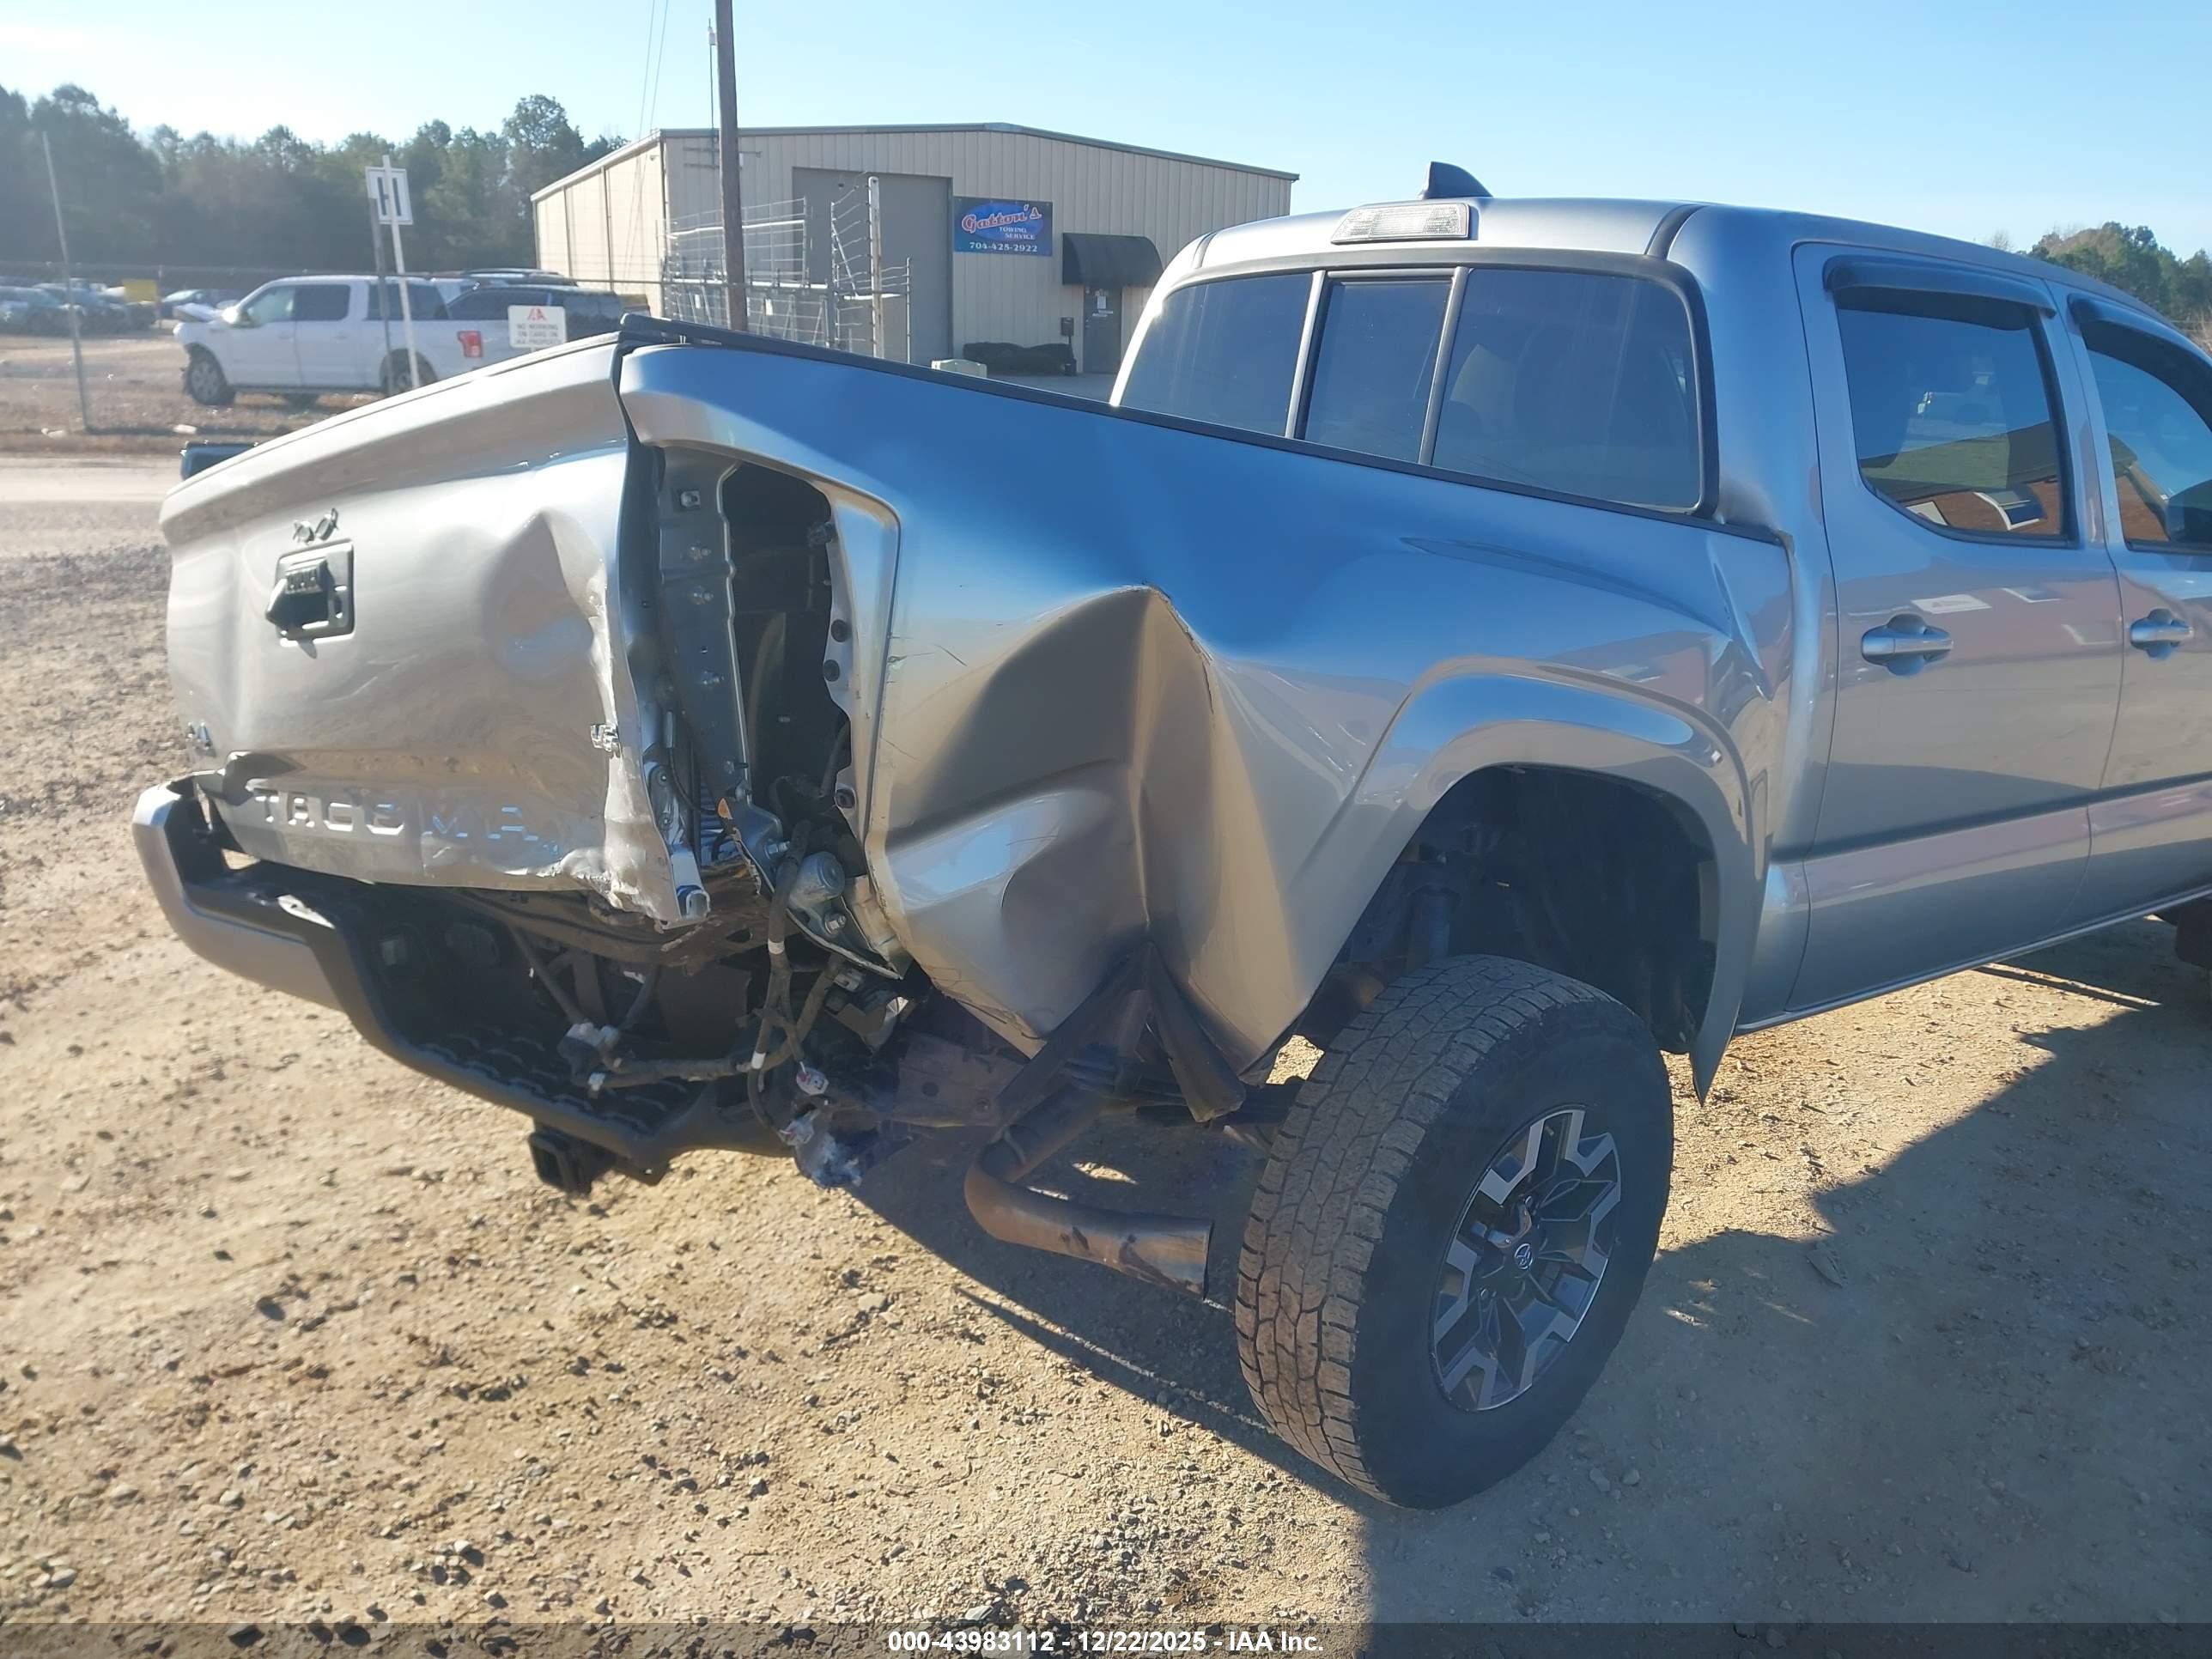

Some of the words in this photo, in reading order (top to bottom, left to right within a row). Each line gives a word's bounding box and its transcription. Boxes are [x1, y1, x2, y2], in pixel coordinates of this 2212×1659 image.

[962, 204, 1042, 234] Gatton's
[969, 241, 1038, 252] 704-425-2922
[254, 785, 540, 842] TACOMA
